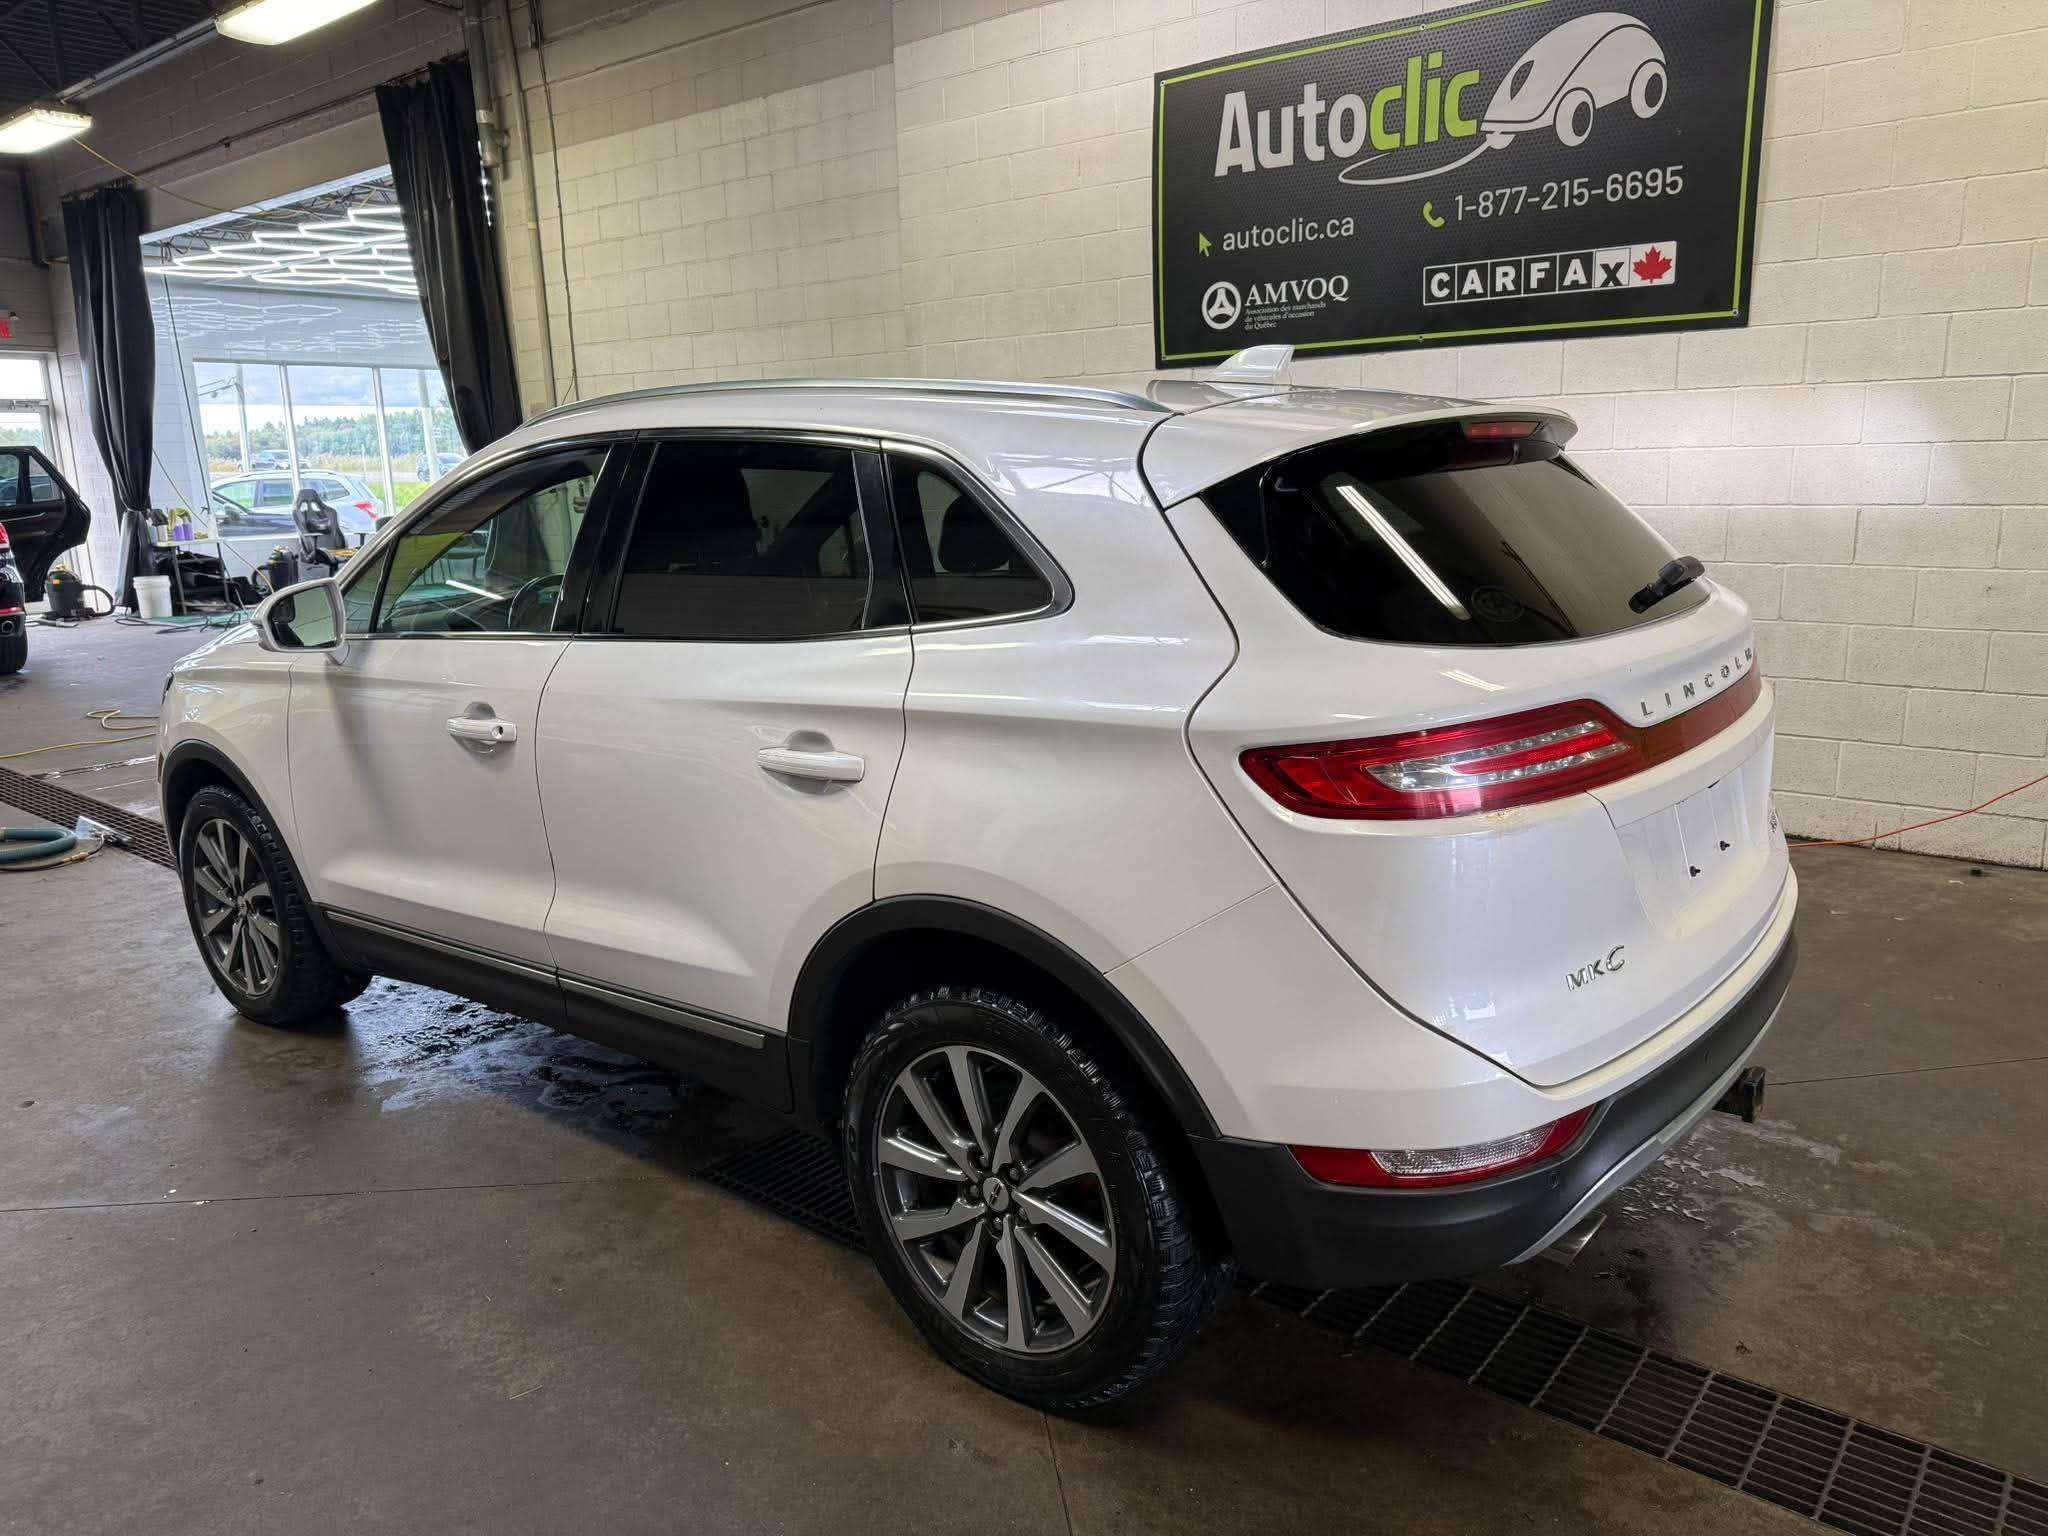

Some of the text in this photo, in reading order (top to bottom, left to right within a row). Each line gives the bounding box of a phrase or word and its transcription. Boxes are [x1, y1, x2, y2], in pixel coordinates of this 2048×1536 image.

[1214, 51, 1480, 177] Autoclic
[1455, 165, 1684, 221] 1-877-215-6695
[1223, 217, 1355, 251] autoclic.ca
[1245, 275, 1350, 306] AMVOQ
[1429, 257, 1625, 298] CARFAX
[1641, 647, 1753, 717] LINCOLN
[1566, 944, 1625, 992] MKC
